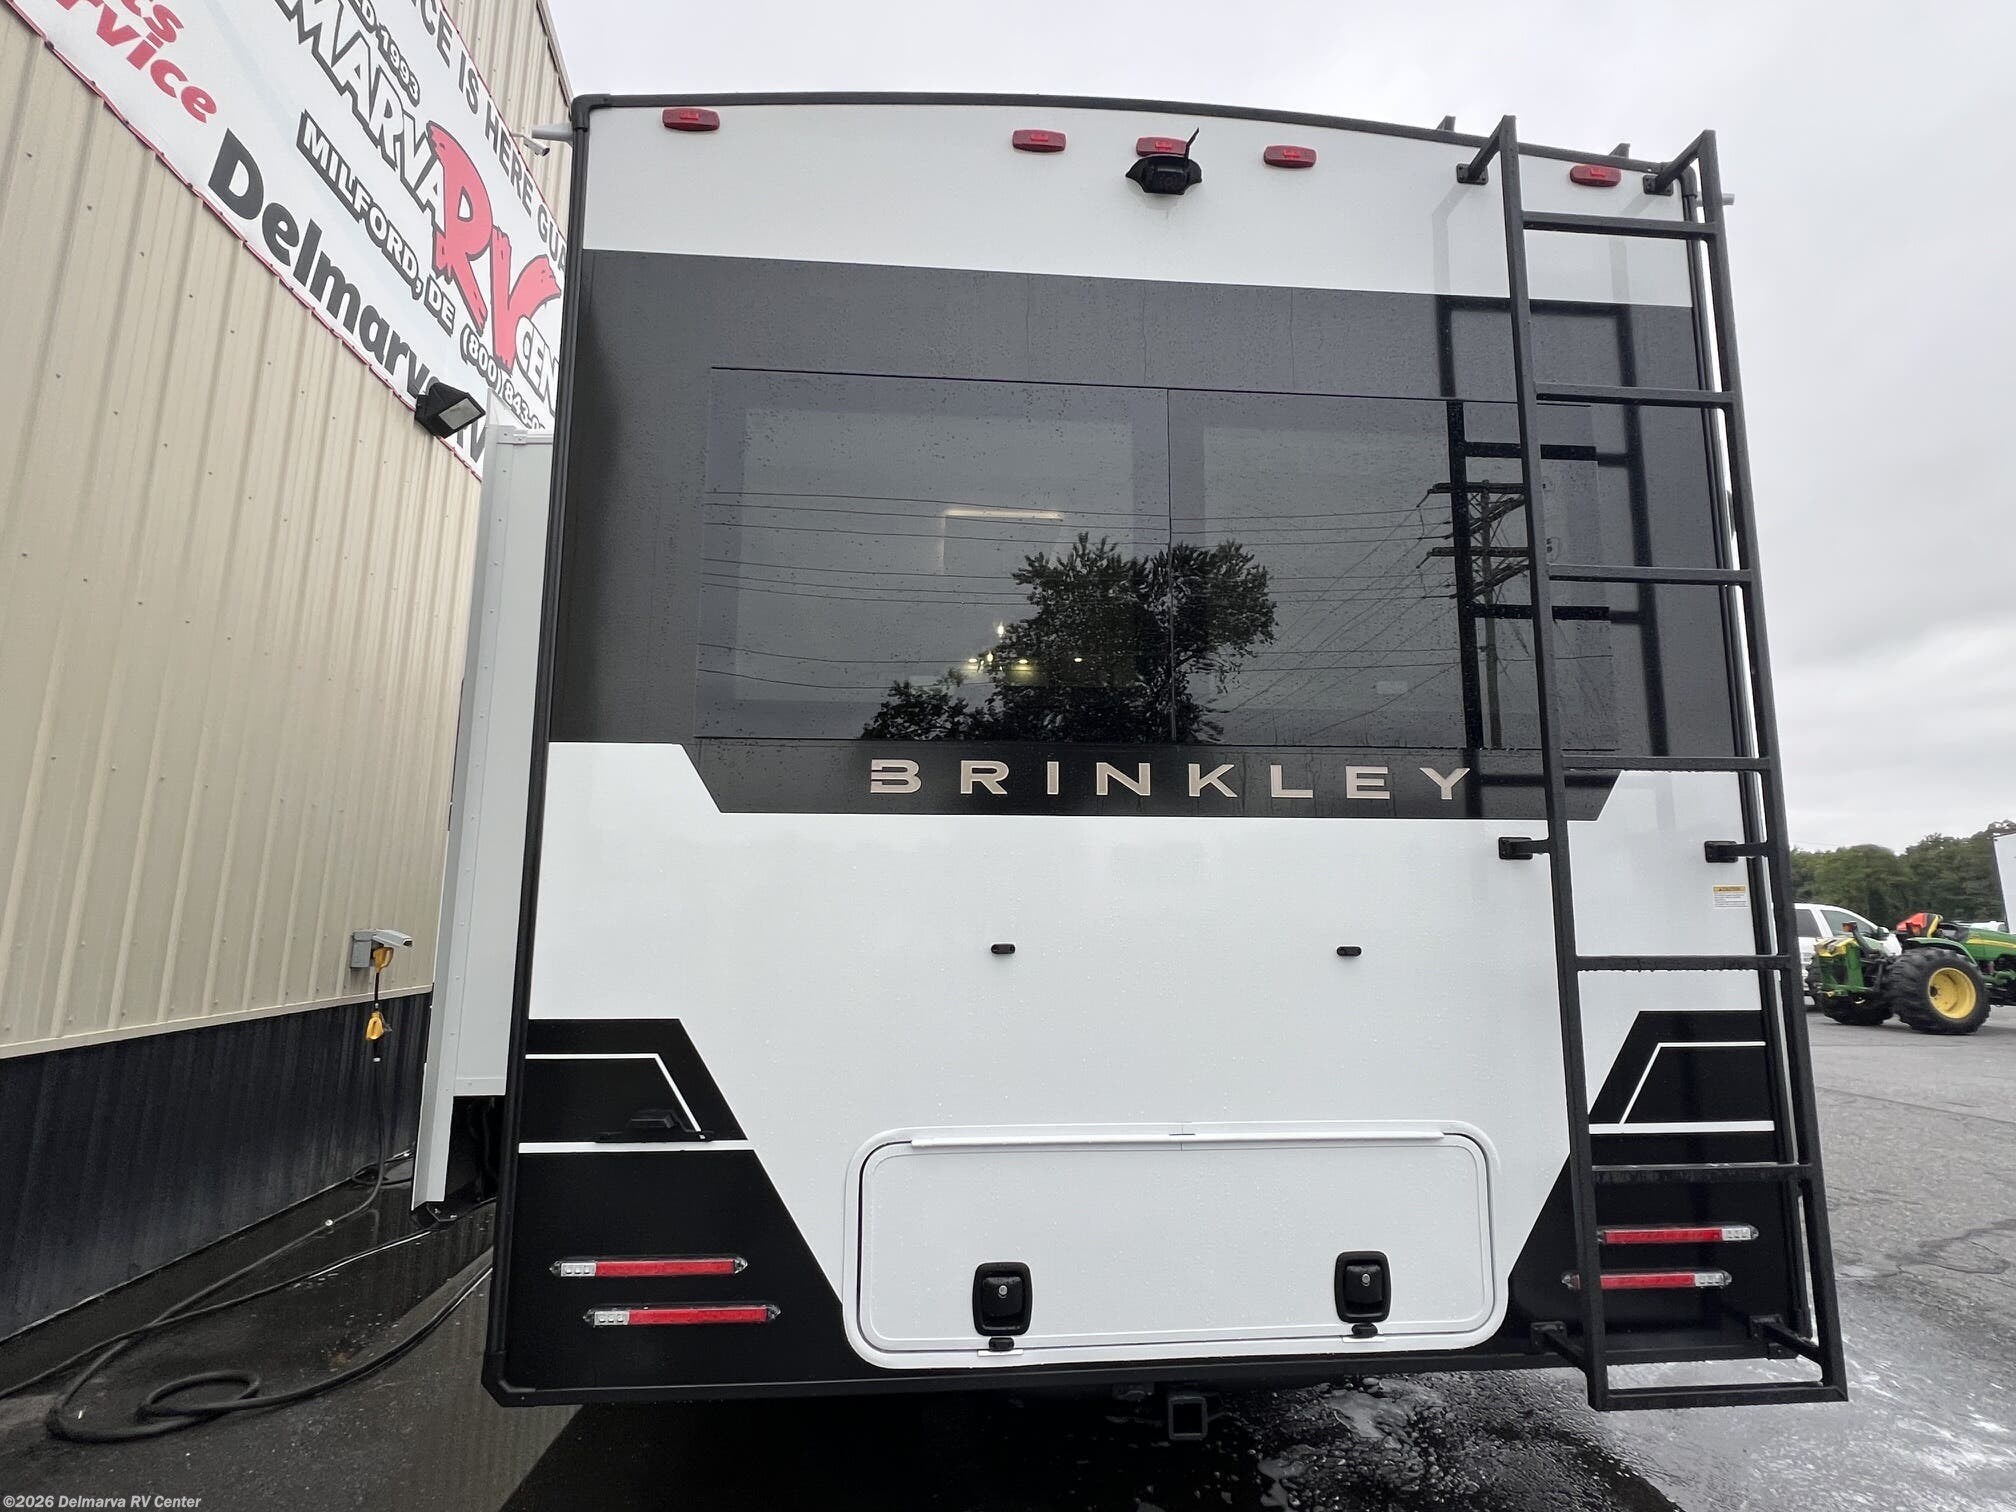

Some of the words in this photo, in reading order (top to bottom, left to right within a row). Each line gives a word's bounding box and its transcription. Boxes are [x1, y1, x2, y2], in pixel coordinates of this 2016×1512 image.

[56, 0, 217, 123] vice
[375, 22, 420, 107] 1993
[458, 50, 479, 115] IS
[485, 100, 533, 218] HERE
[208, 127, 442, 400] Delmarv
[275, 0, 447, 239] MARVA
[426, 120, 562, 375] RV
[296, 108, 424, 301] MILFORD,
[424, 275, 456, 338] DE
[460, 323, 502, 396] (800)
[870, 758, 1470, 800] BRINKLEY
